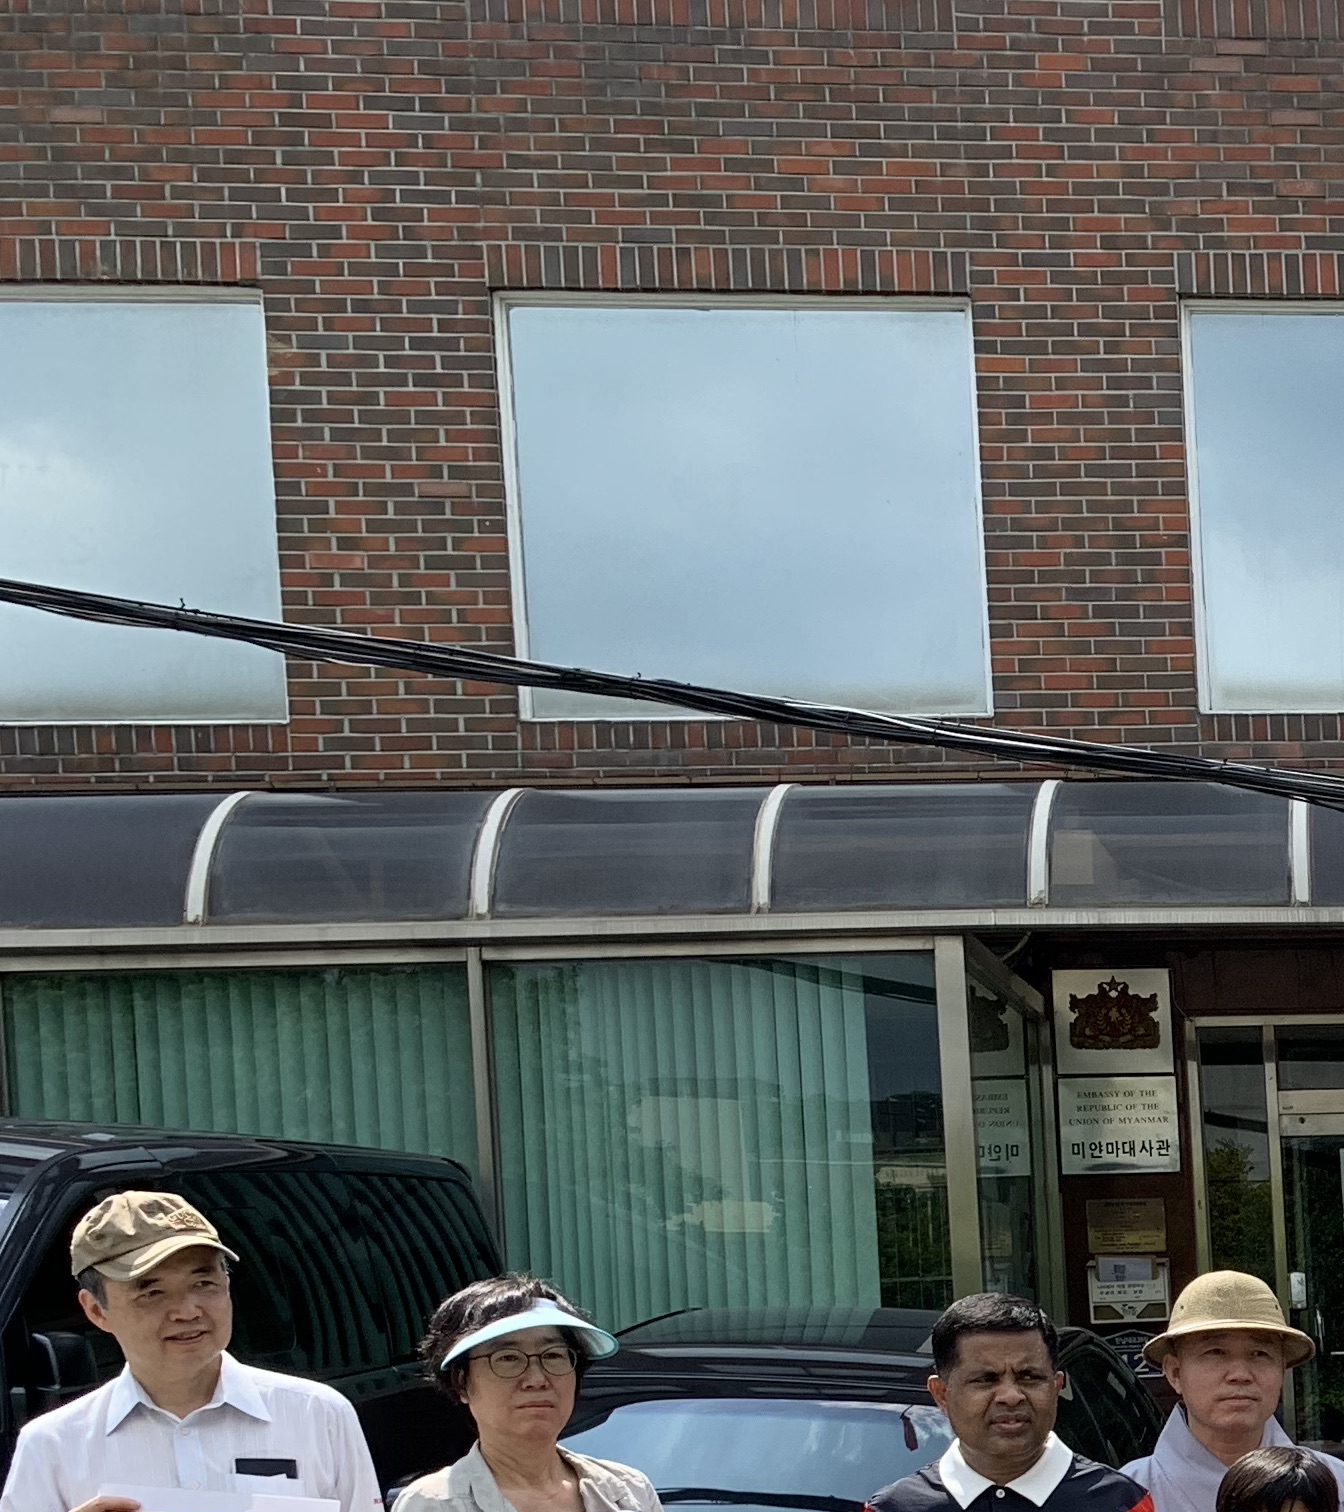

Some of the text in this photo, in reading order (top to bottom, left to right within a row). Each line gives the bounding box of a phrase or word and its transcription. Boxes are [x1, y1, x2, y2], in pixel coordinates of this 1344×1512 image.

[1077, 1089, 1157, 1100] EMBASSY OF THE
[1076, 1103, 1159, 1113] REPUBLIC OF THE
[1068, 1116, 1169, 1126] UNION OF MYANMAR
[1072, 1139, 1170, 1159] 미얀마대사관
